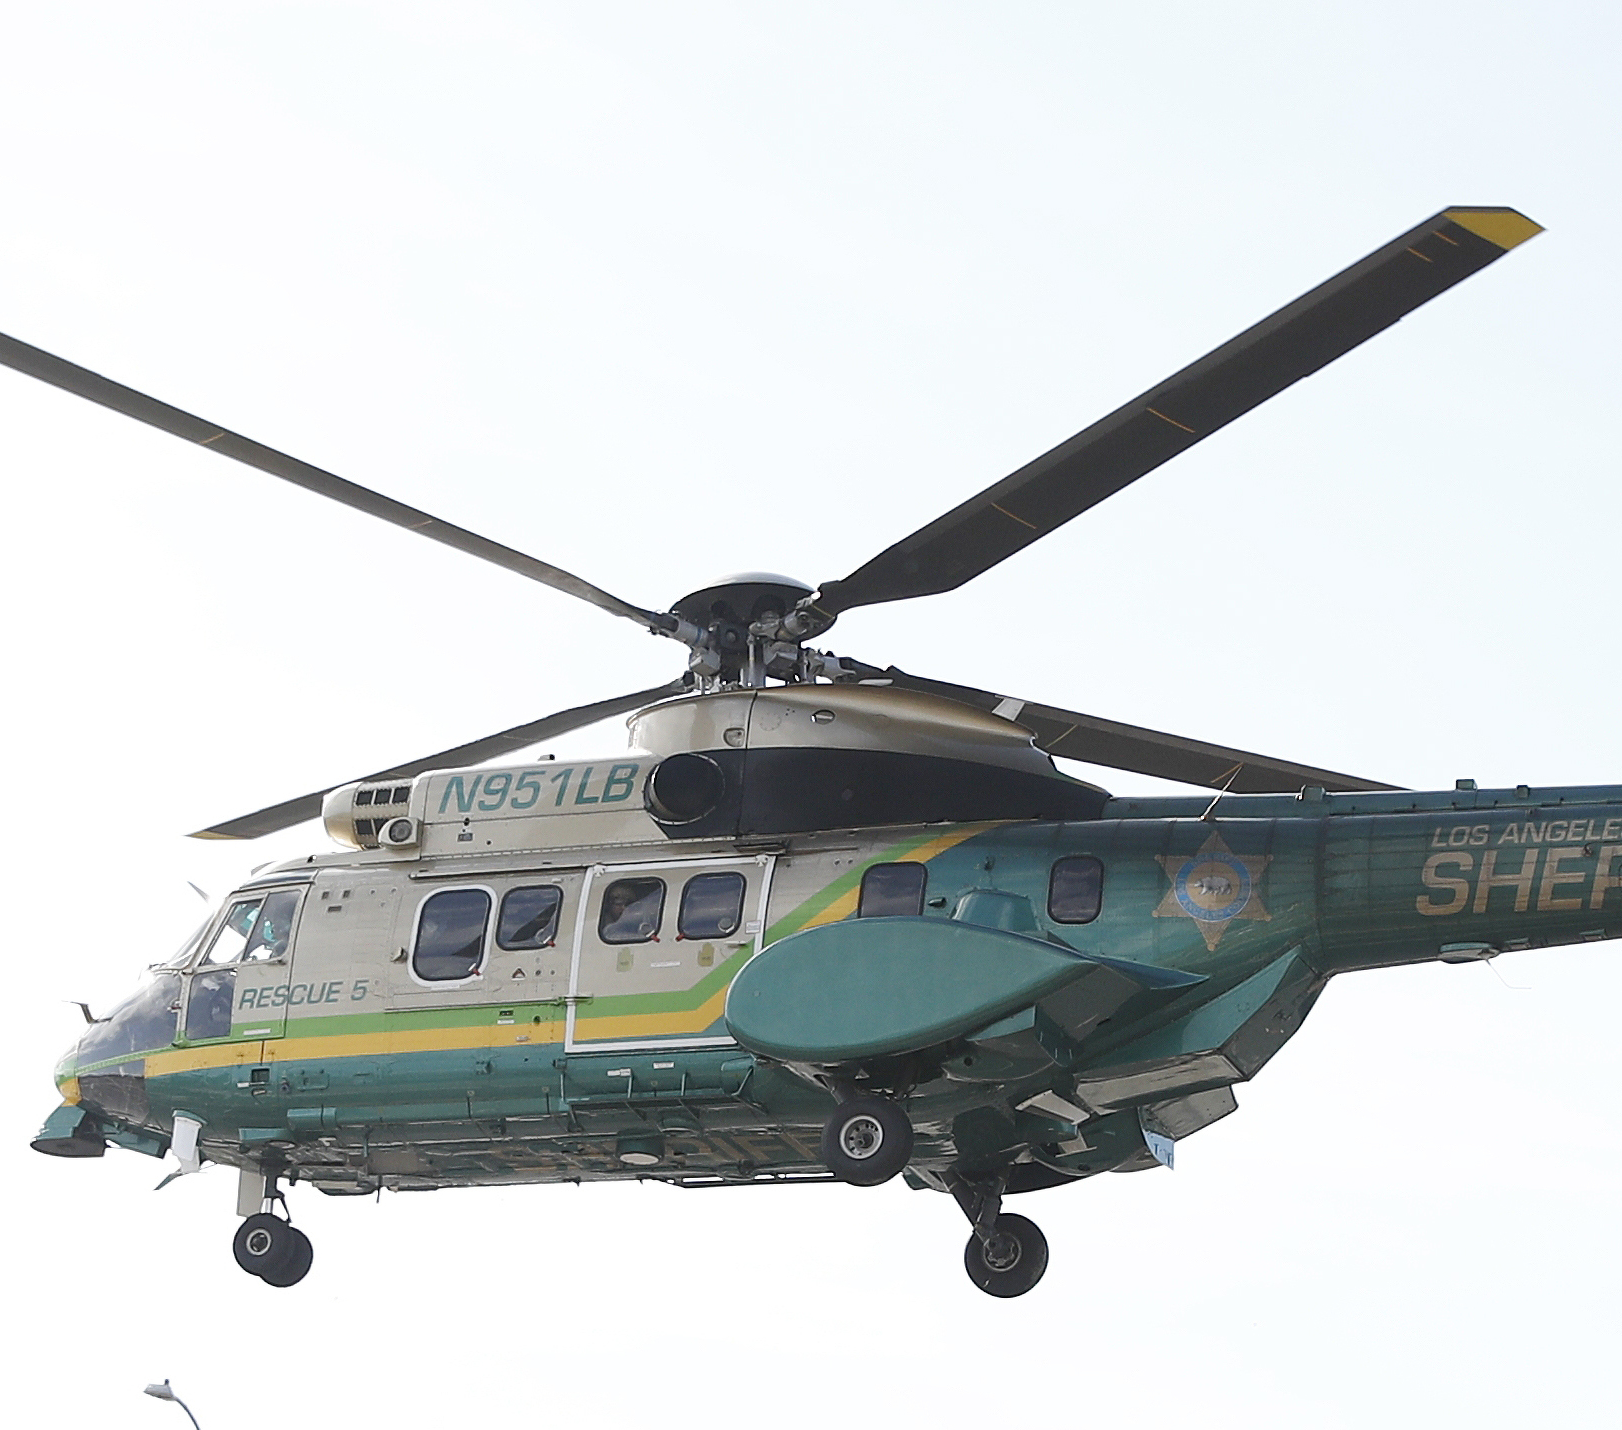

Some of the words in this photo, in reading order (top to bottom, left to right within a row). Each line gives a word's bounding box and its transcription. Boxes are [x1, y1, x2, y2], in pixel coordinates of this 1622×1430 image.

[438, 763, 640, 814] N951LB
[1431, 825, 1490, 848] LOS
[238, 981, 344, 1011] RESCUE
[350, 979, 369, 1001] 5
